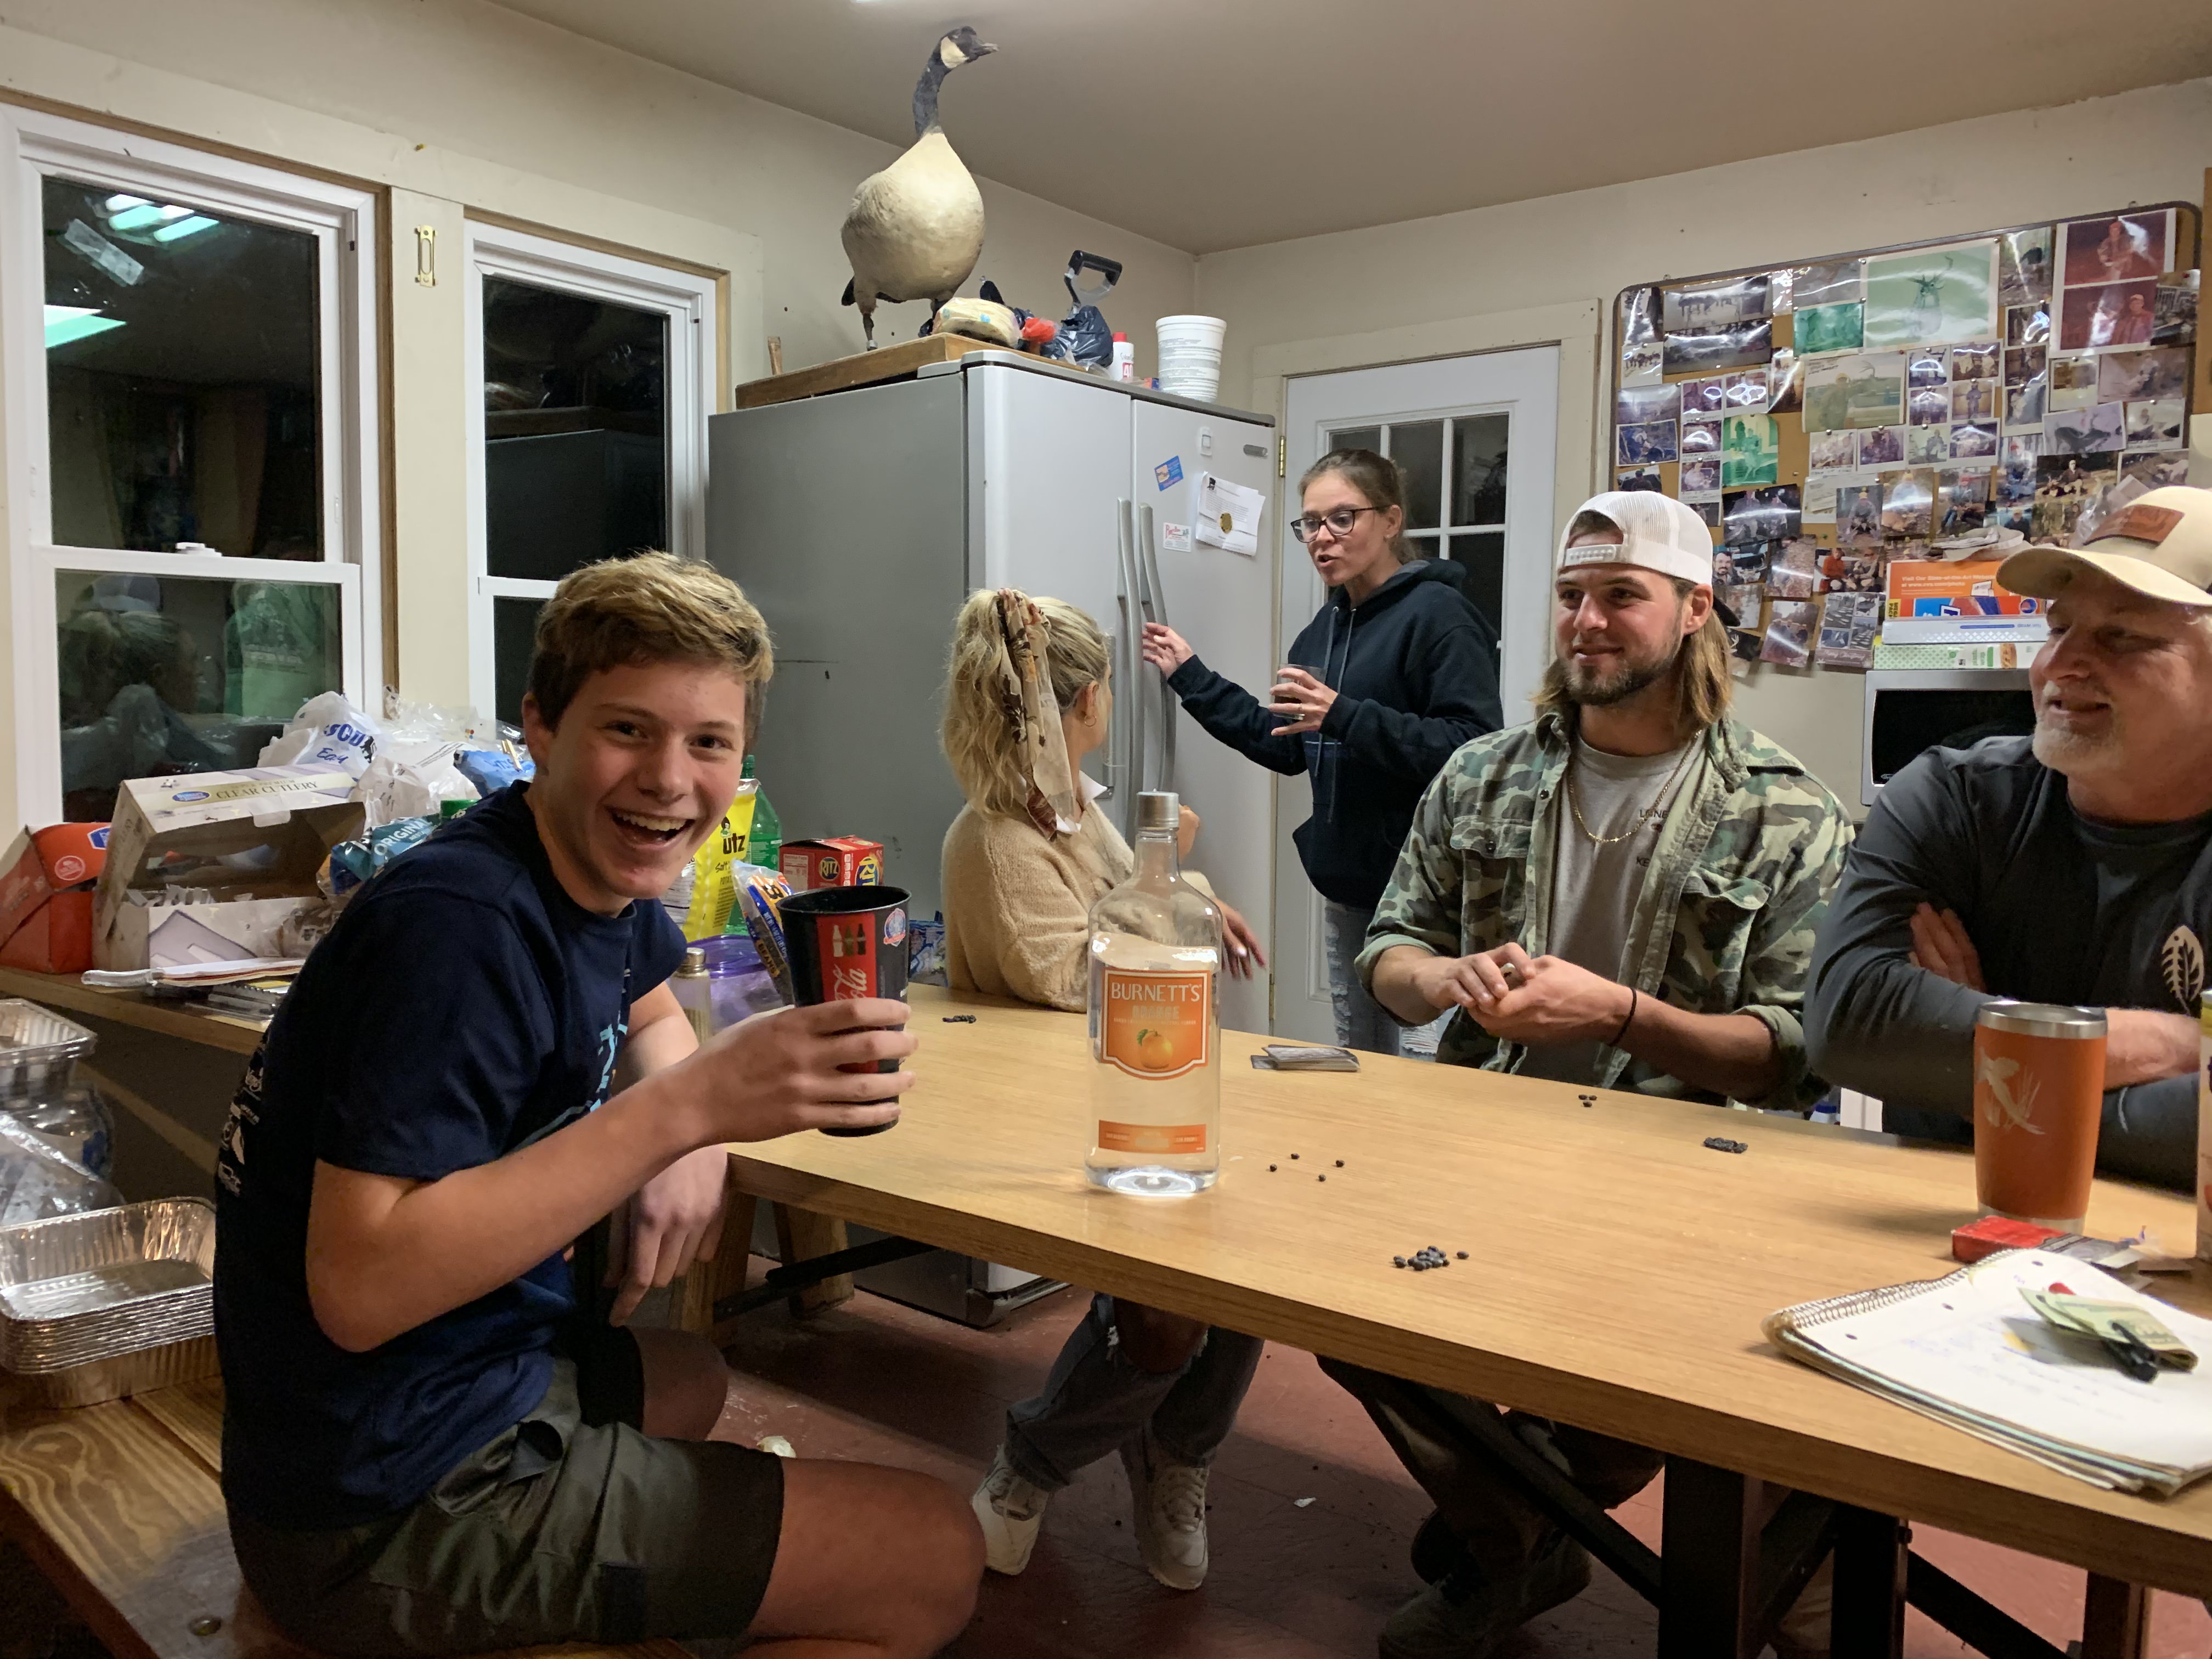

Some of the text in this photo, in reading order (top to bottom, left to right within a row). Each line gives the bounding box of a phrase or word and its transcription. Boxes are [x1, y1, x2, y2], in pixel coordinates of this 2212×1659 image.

[216, 788, 259, 800] CLEAR
[261, 781, 318, 794] CUTLERY
[723, 833, 746, 855] utz
[821, 860, 839, 877] RITZ
[859, 859, 878, 886] RIT
[1111, 981, 1200, 1002] BURNETT'S
